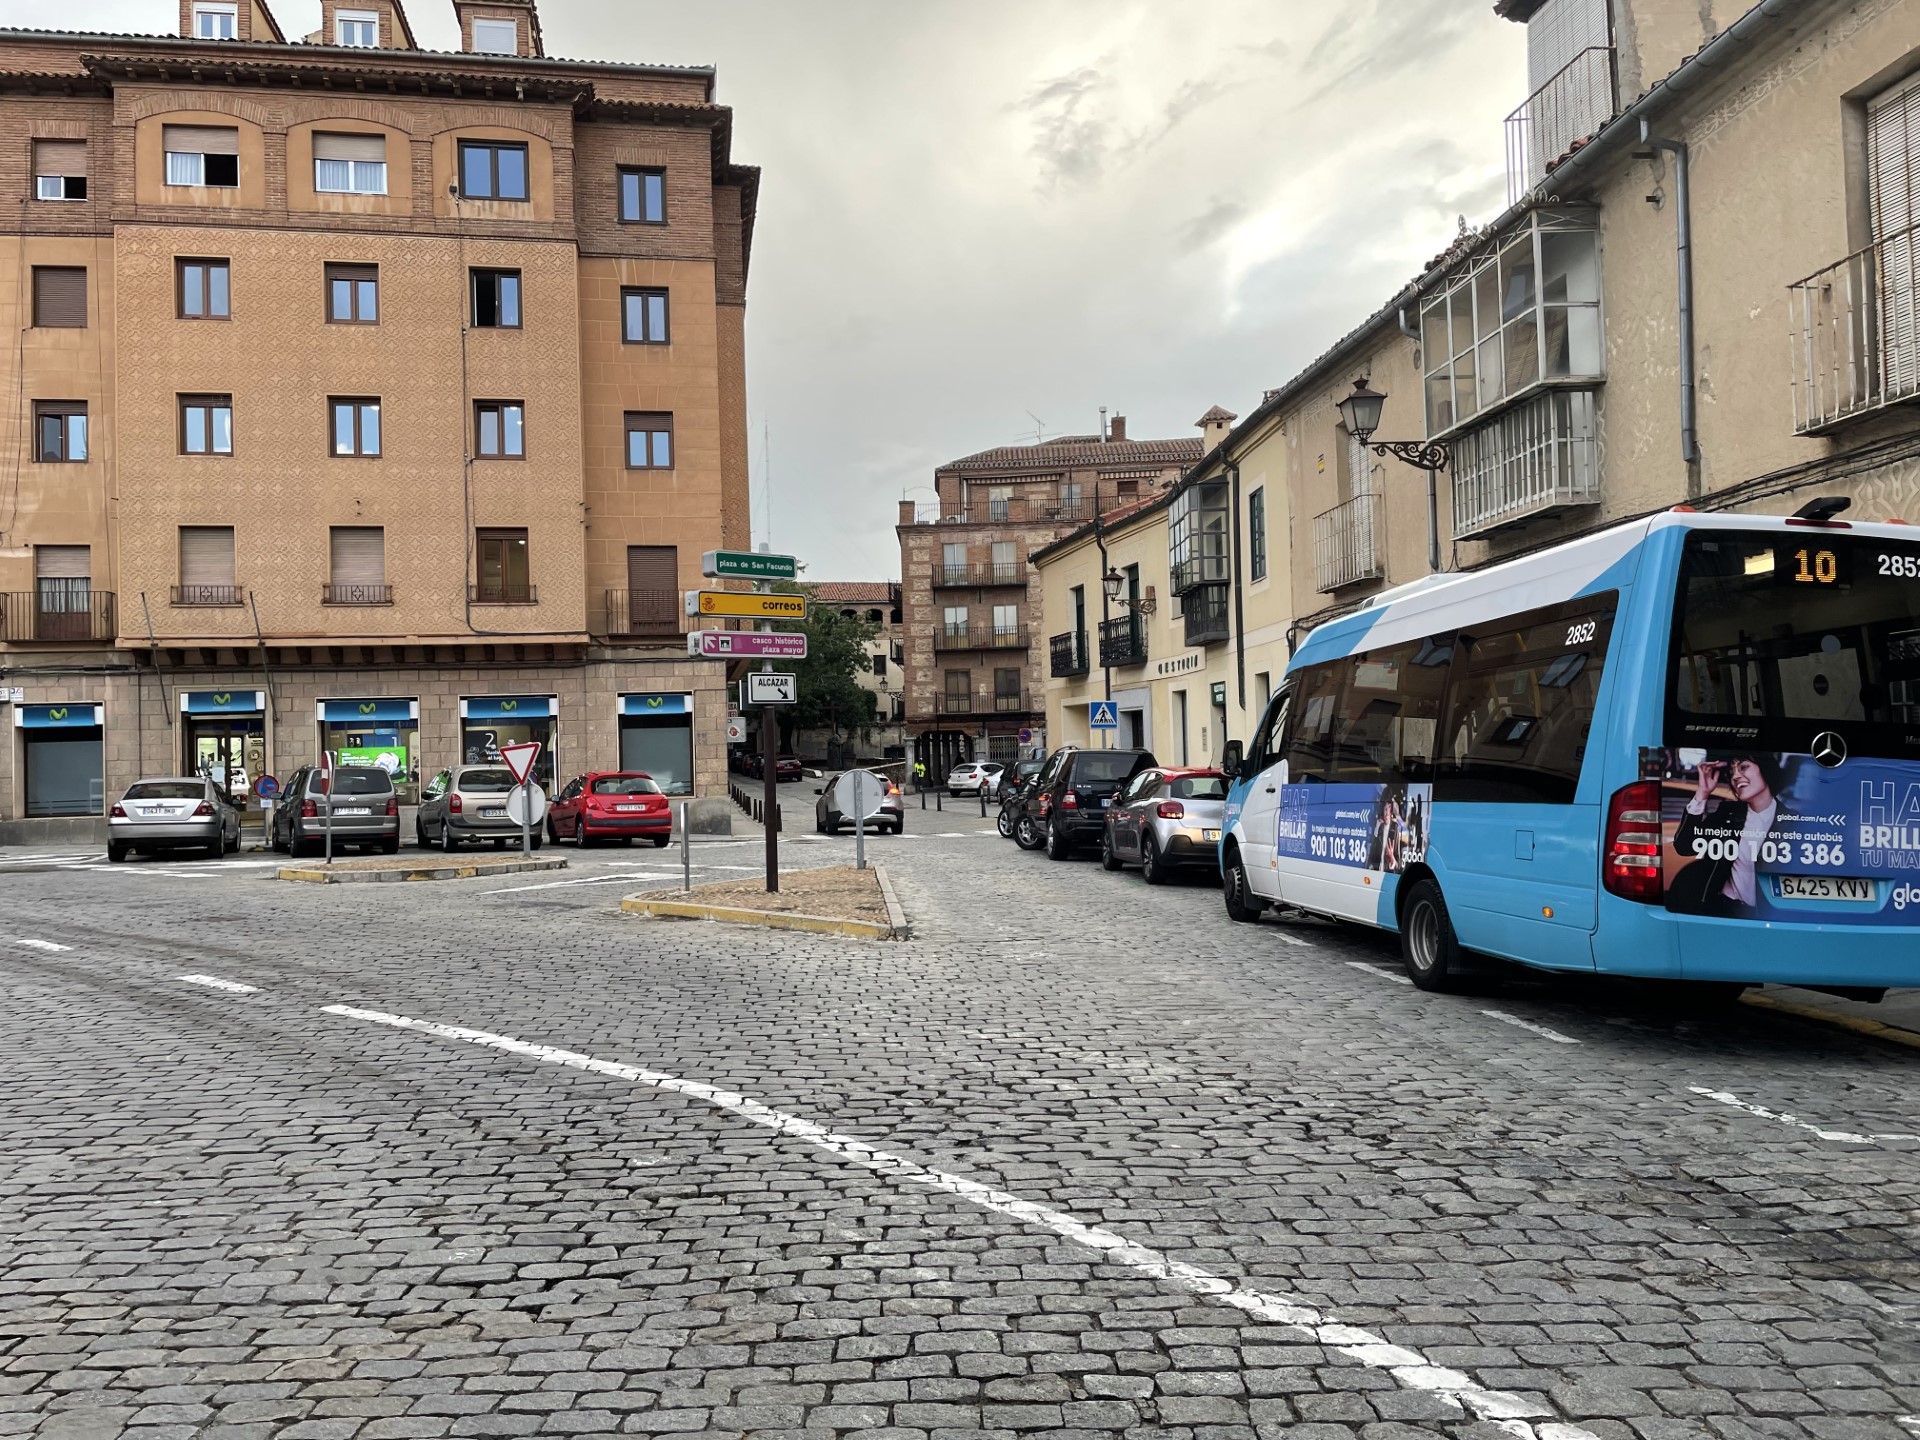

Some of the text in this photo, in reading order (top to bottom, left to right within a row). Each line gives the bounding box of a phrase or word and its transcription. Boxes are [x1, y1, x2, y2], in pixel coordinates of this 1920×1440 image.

[719, 559, 793, 571] plaza de San Facundo
[1794, 549, 1836, 583] 10
[762, 600, 803, 611] correos
[752, 636, 804, 645] casco histórico
[1564, 621, 1596, 646] 2852
[762, 645, 804, 655] plaza mayor
[757, 677, 789, 687] ALCÁZAR
[1684, 724, 1759, 734] SPRINTER
[1280, 788, 1310, 822] HAZ
[1776, 813, 1827, 824] global.com/es
[1279, 821, 1307, 840] BRILLAR
[1315, 824, 1325, 834] mejor
[1350, 827, 1367, 838] autobús
[1694, 826, 1843, 842] tu mejor versión en este autobús
[1310, 835, 1367, 863] 900 103 386
[1691, 838, 1846, 867] 900 103 386
[1859, 850, 1920, 869] TU MA
[1783, 878, 1830, 897] 6425
